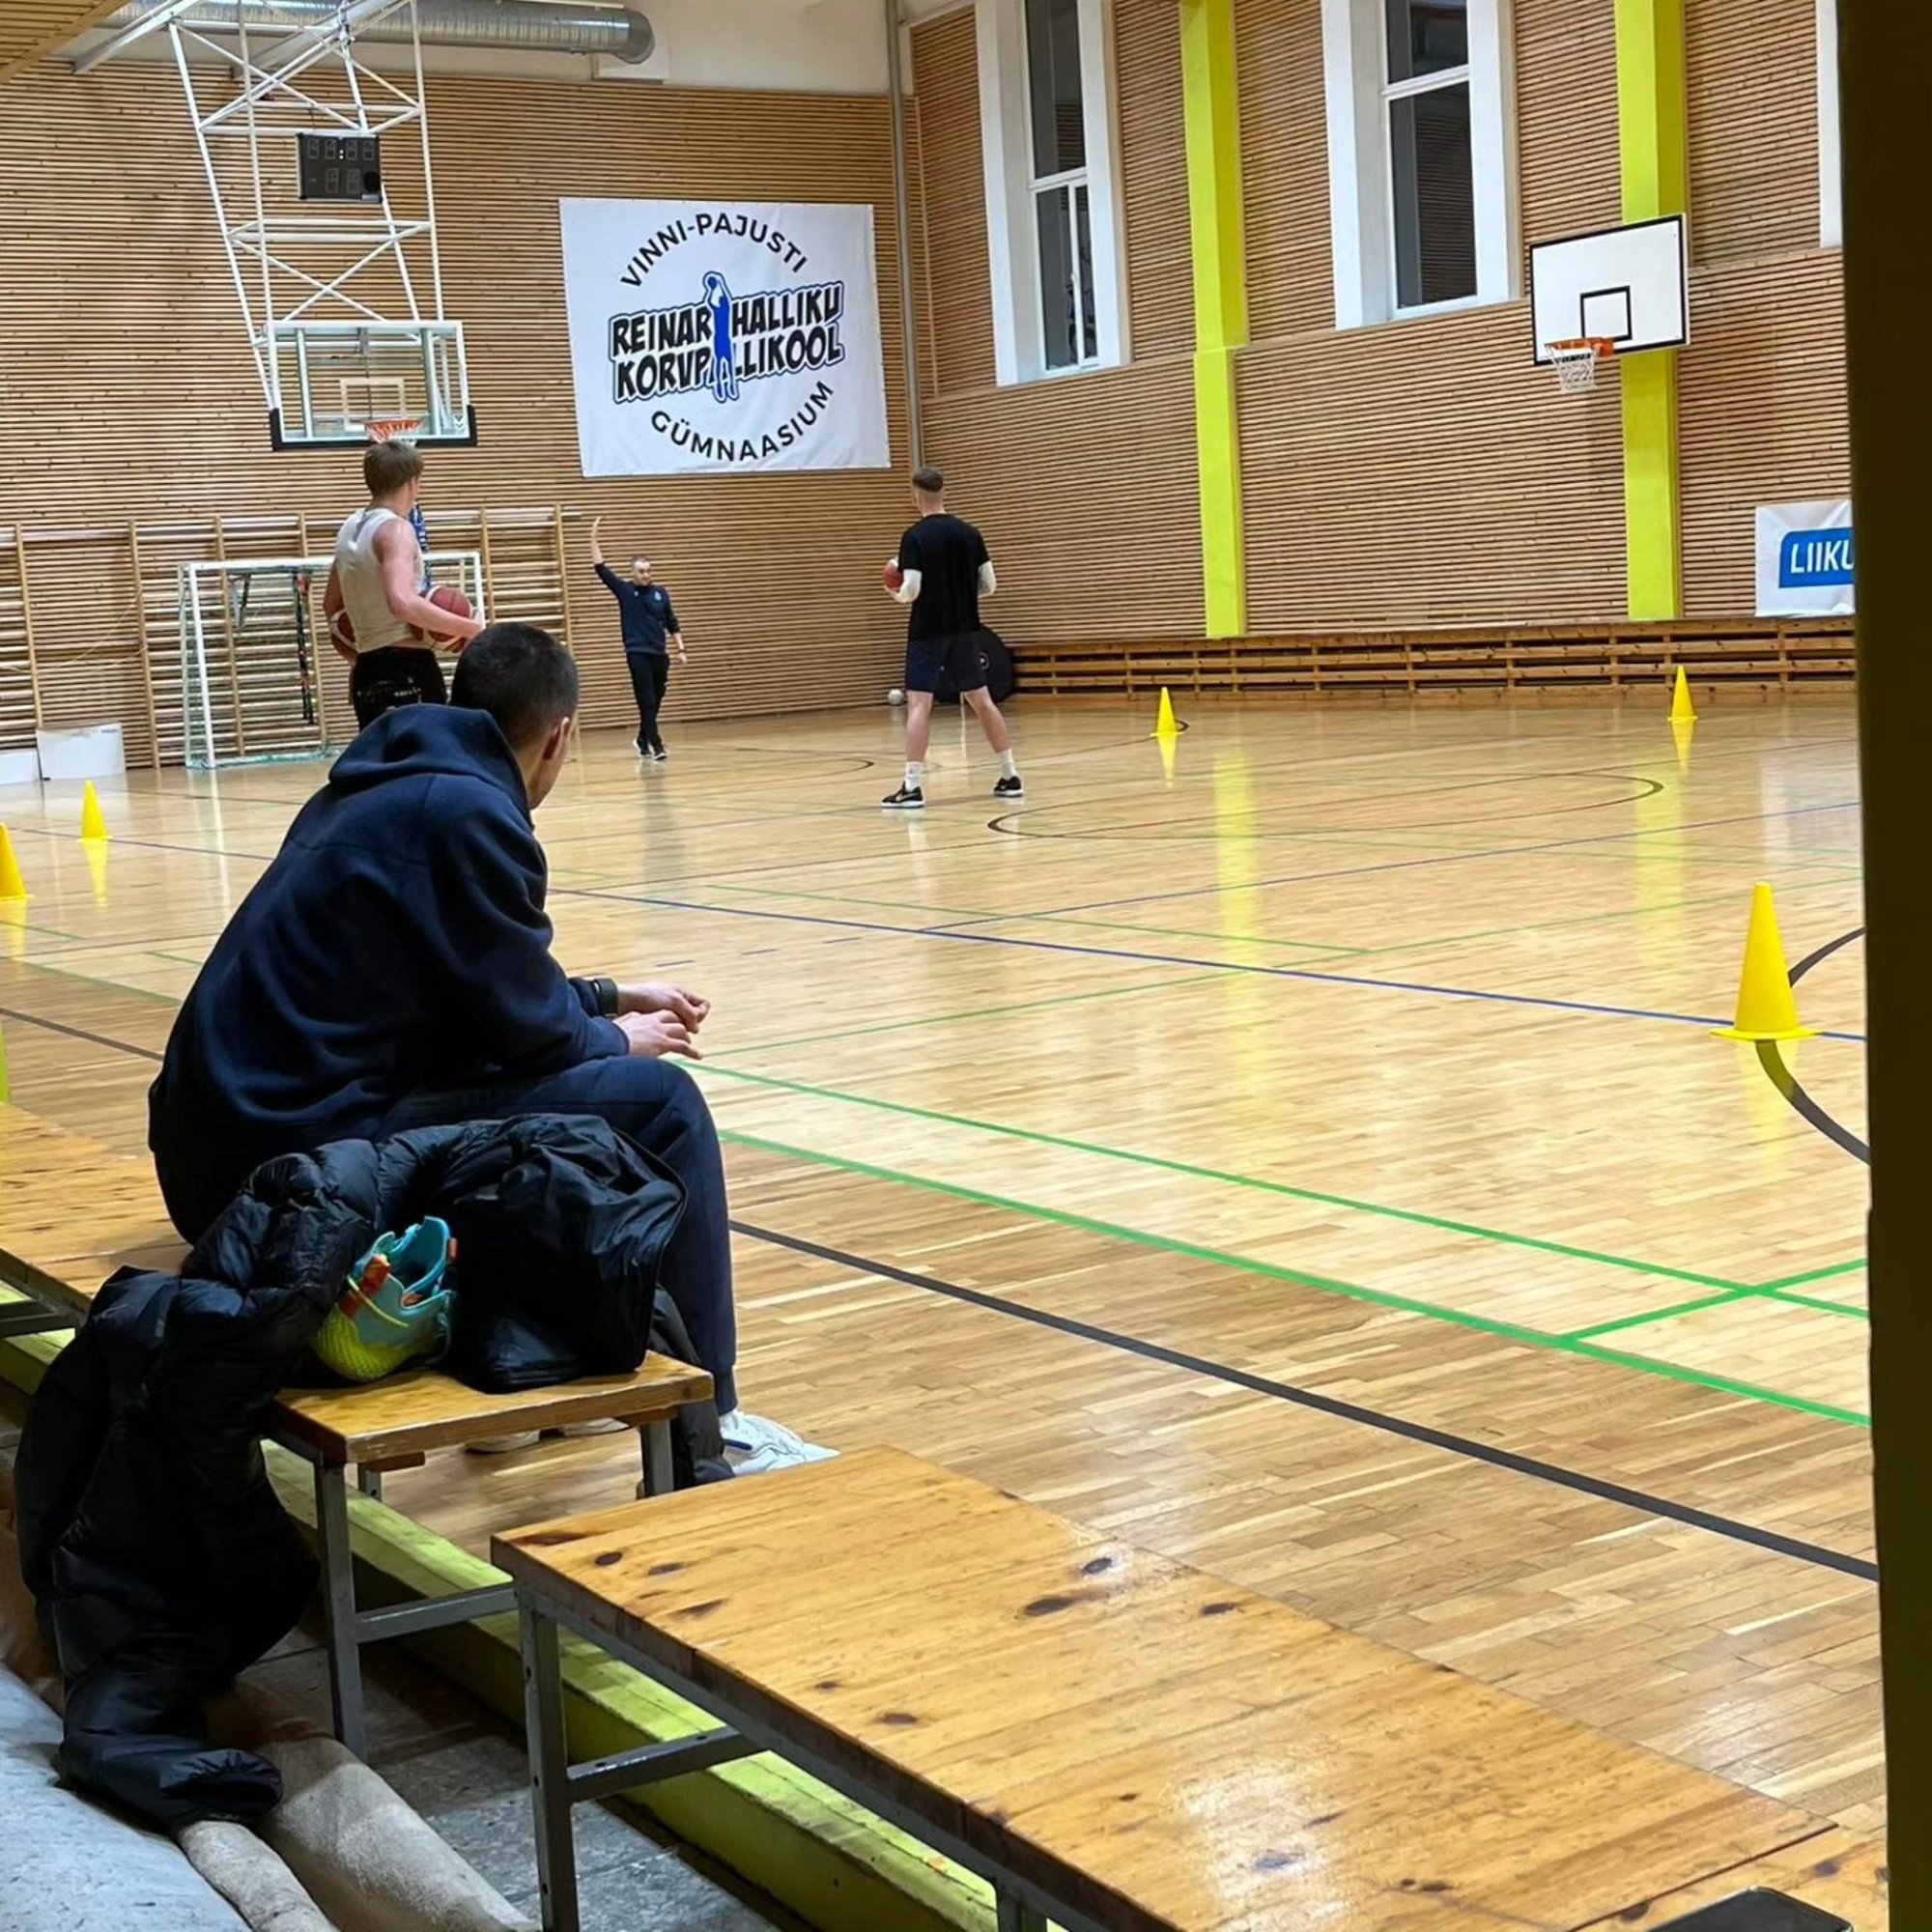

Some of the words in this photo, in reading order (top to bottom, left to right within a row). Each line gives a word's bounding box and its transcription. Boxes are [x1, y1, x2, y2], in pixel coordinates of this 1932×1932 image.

[620, 212, 808, 287] VINNI-PAJUSTI
[612, 305, 713, 357] REINAR
[732, 285, 841, 337] HALLIKU
[651, 381, 835, 462] GÜMNAASIUM
